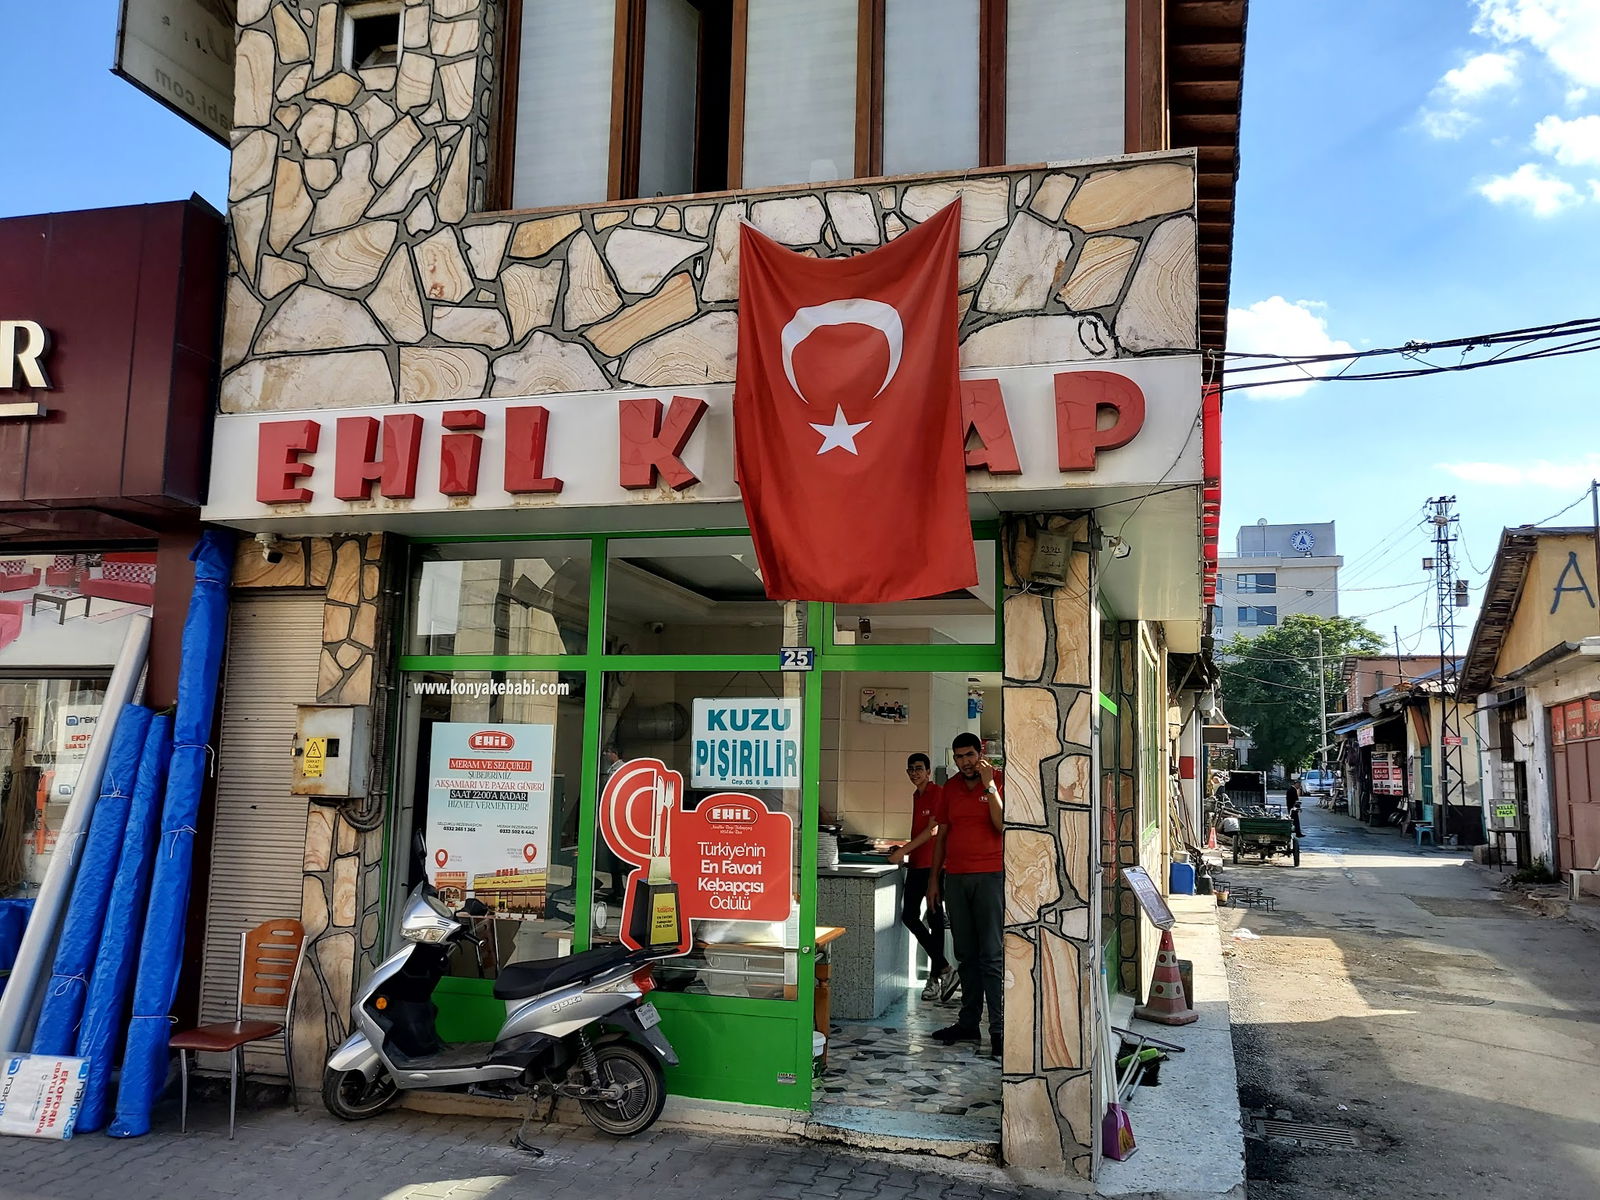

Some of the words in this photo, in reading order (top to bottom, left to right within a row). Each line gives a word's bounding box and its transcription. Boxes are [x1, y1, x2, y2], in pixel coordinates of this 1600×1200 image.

[0, 320, 53, 389] R
[1550, 551, 1596, 614] A
[784, 651, 808, 666] 25
[413, 679, 569, 698] www.konyakebabi.com
[707, 708, 791, 731] KUZU
[451, 760, 480, 769] MERAM
[481, 760, 493, 769] VE
[494, 761, 531, 771] SELÇUKLU
[696, 739, 797, 780] PİŞİRİLİR
[480, 781, 490, 789] VE
[491, 782, 515, 790] PAZAR
[451, 790, 471, 798] SAAT
[500, 792, 526, 801] KADAR
[697, 842, 765, 860] Türkiye'nin
[701, 860, 718, 873] En
[722, 860, 762, 875] Favori
[698, 877, 764, 895] Kebapçısı
[709, 892, 751, 910] Ödülü
[47, 1070, 69, 1128] EKOFORM
